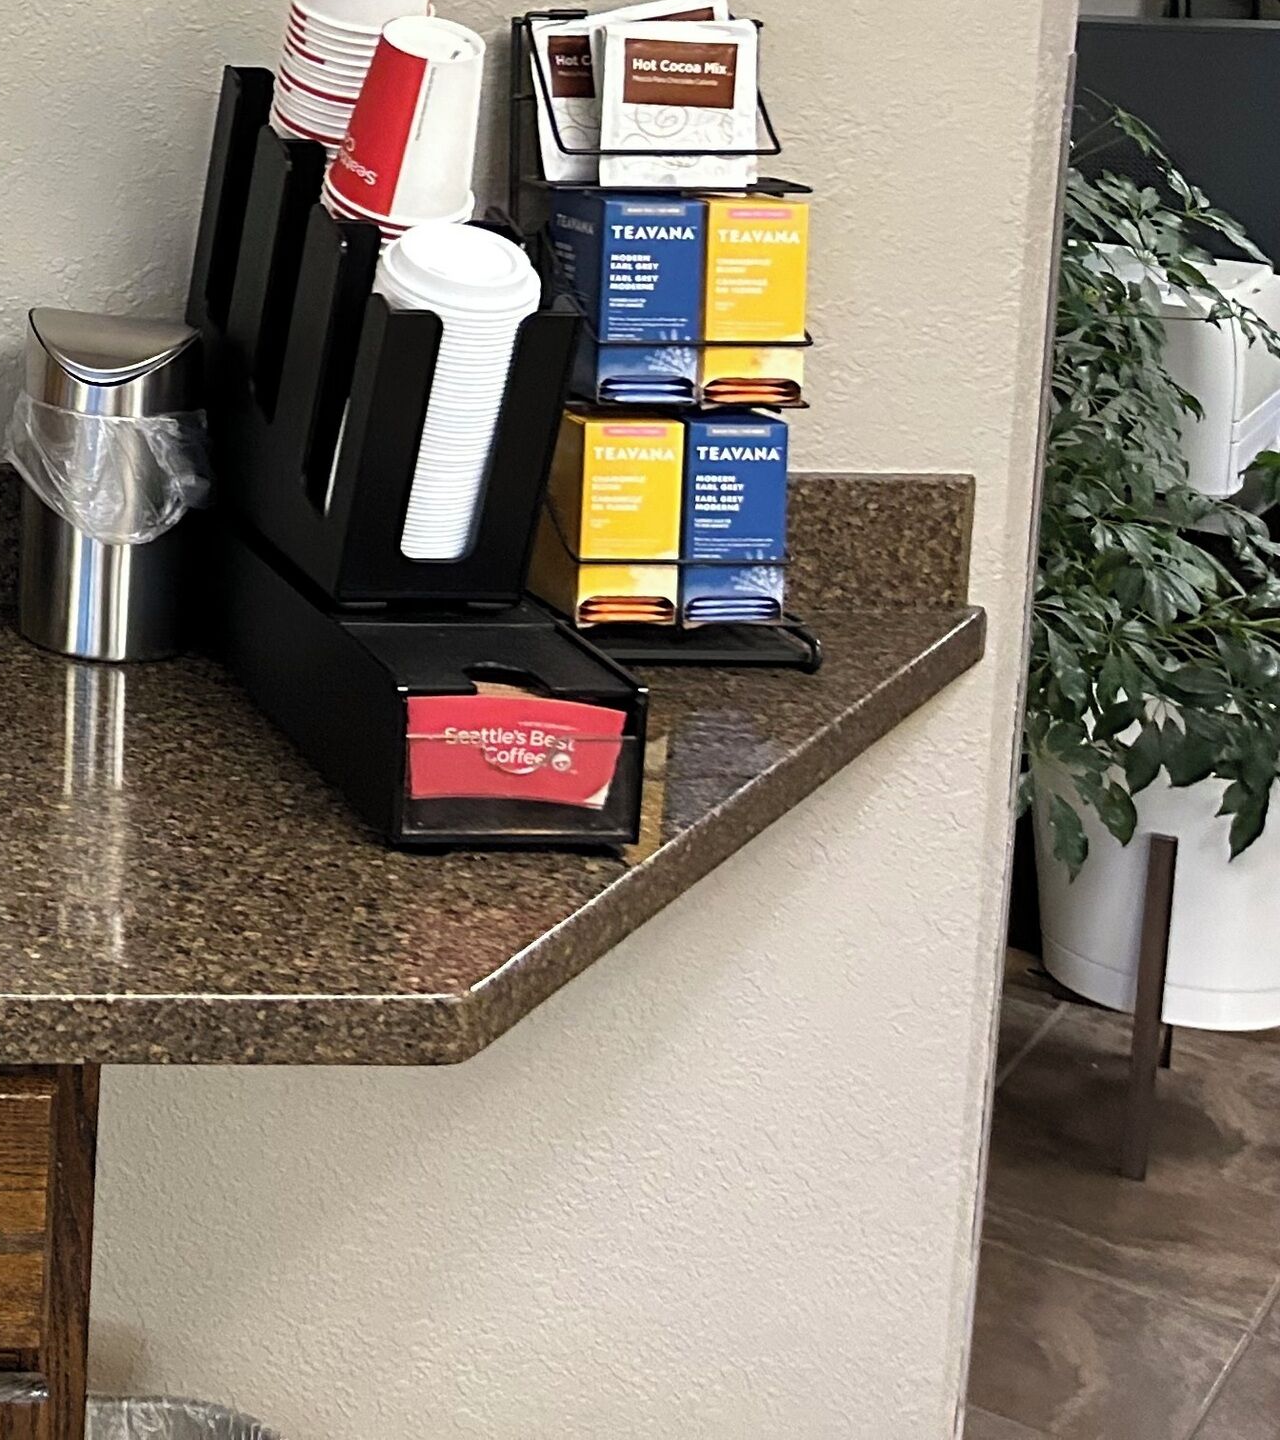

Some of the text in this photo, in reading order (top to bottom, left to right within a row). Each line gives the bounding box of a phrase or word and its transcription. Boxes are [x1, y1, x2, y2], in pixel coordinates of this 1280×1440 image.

[555, 55, 579, 66] Hot
[632, 58, 728, 76] Hot Cocoa Mix
[611, 225, 695, 240] TEAVANA
[717, 229, 801, 245] TEAVANA
[593, 446, 676, 462] TEAVANA
[696, 446, 780, 461] TEAVANA
[444, 726, 527, 745] Seattle's
[529, 729, 576, 752] Best
